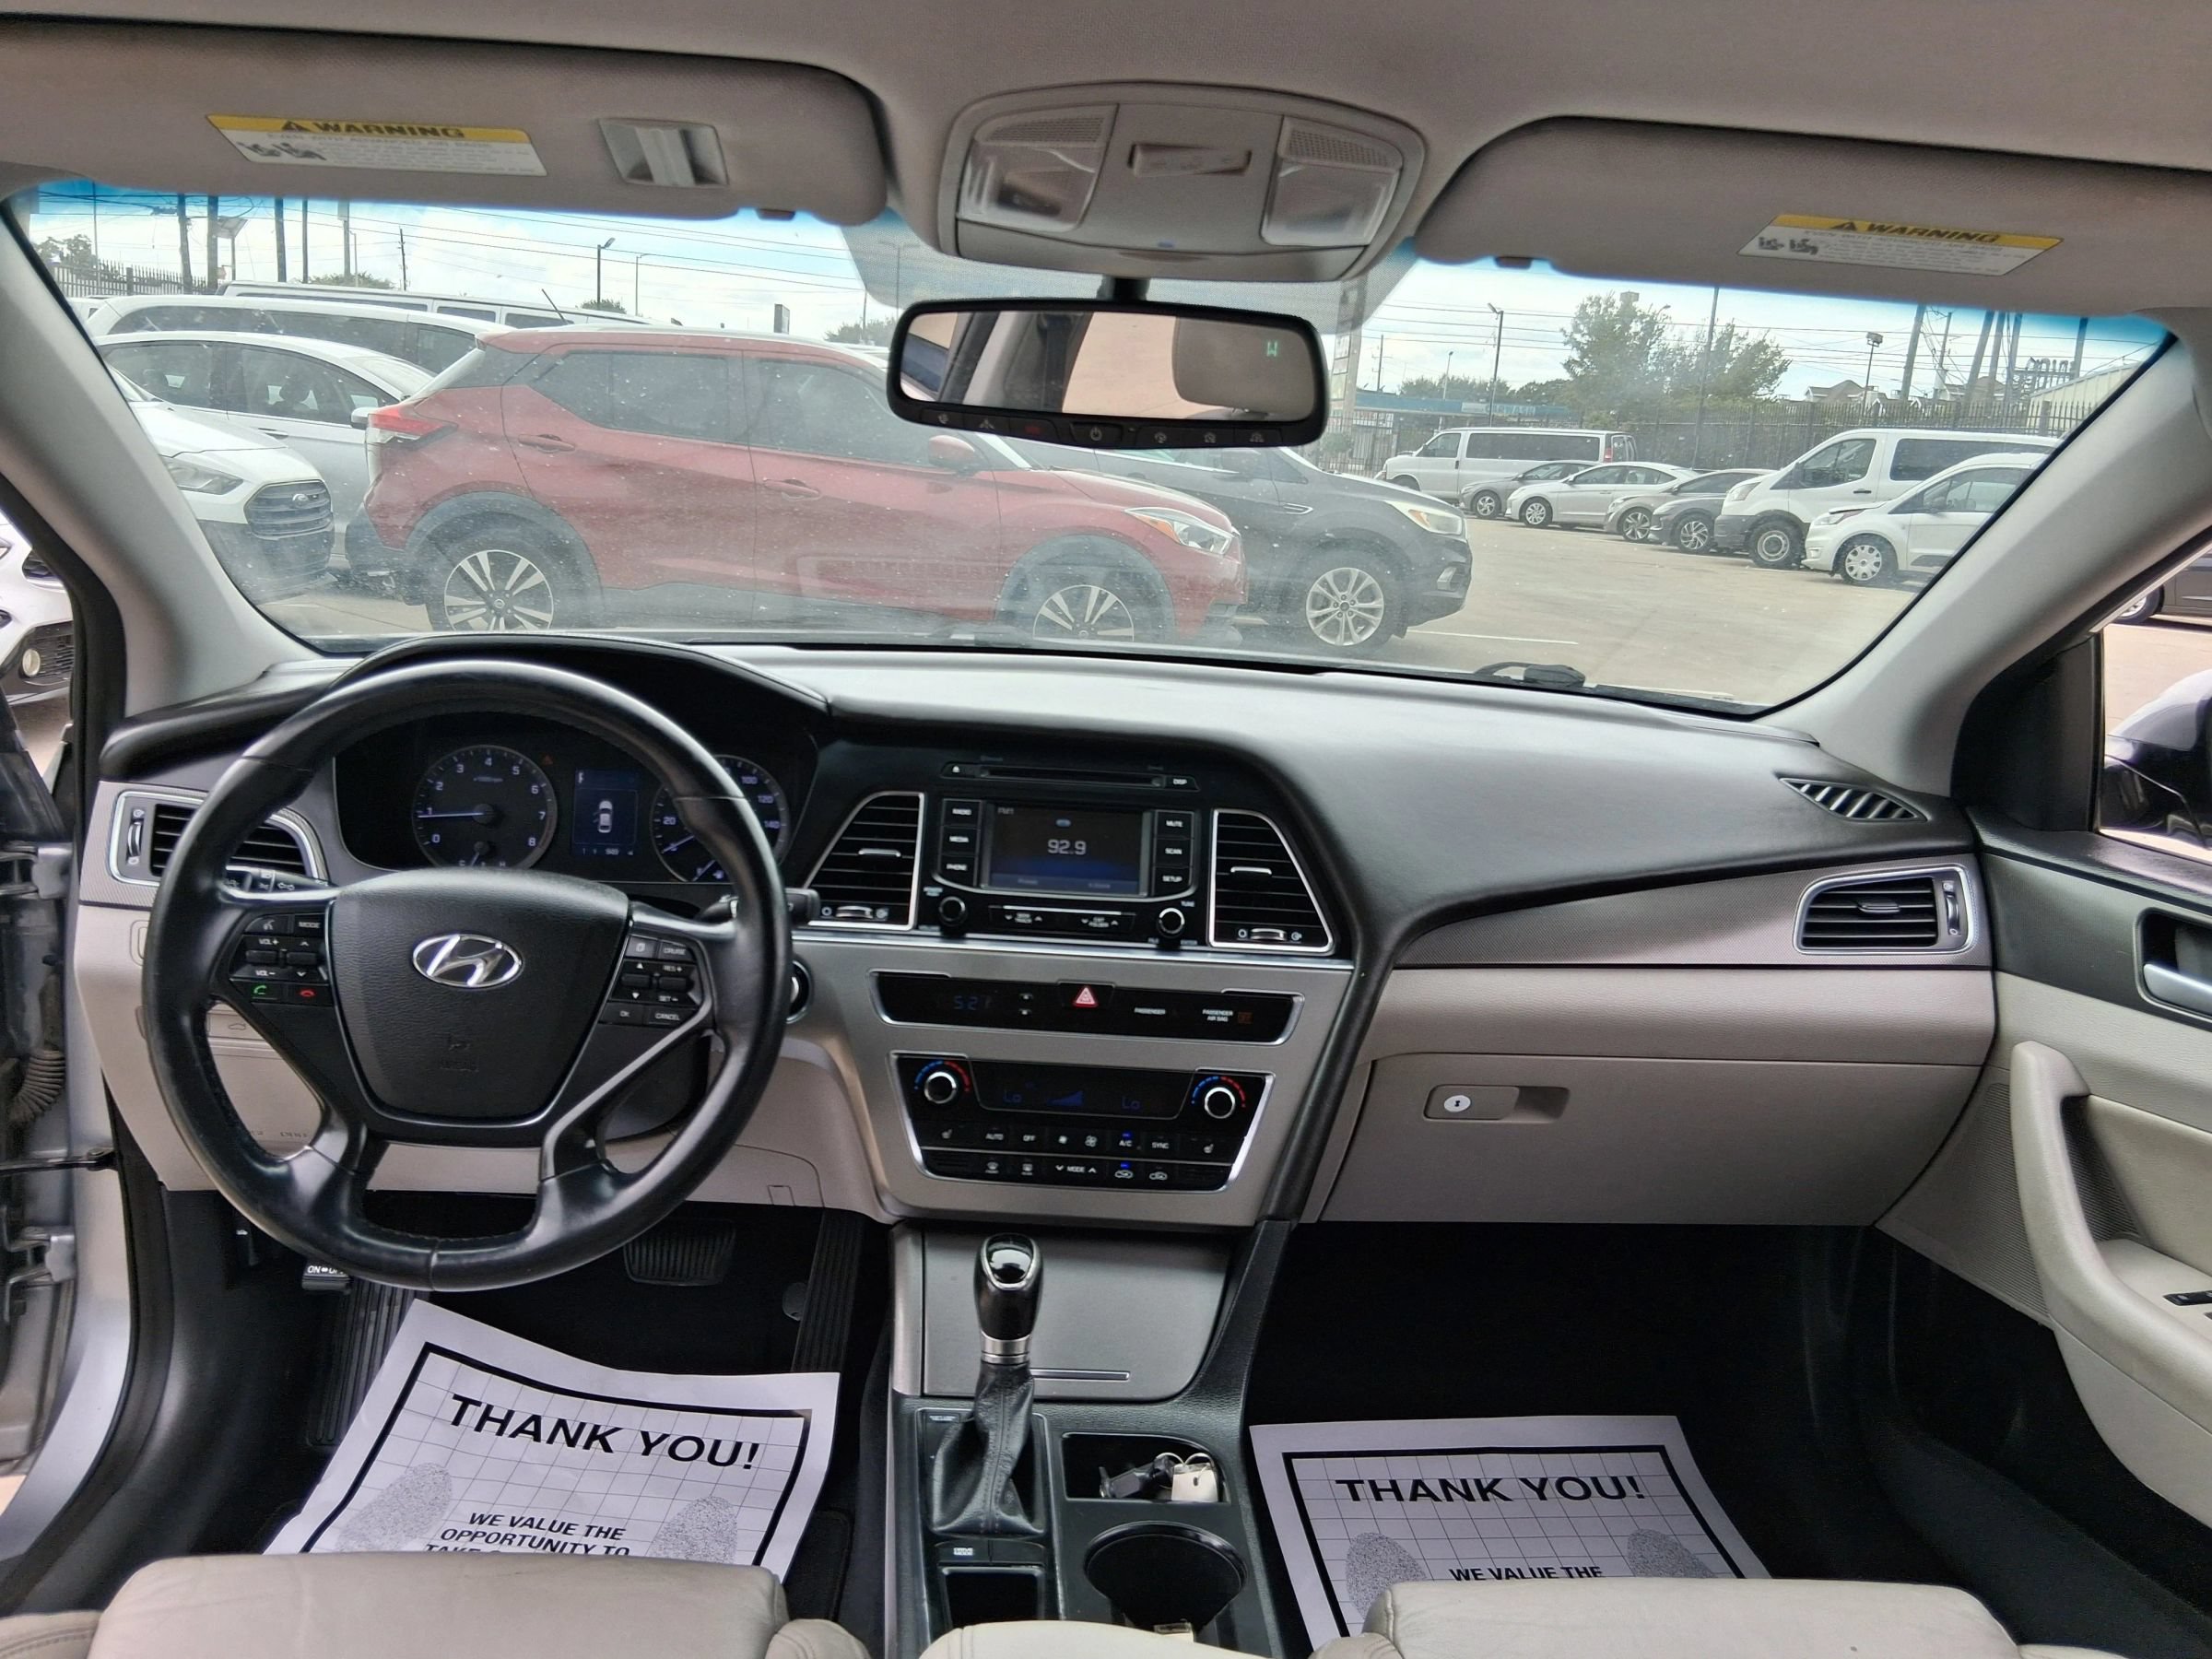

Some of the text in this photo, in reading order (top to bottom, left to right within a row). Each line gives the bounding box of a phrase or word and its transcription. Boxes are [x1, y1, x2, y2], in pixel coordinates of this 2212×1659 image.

[312, 122, 465, 138] WARNING
[1867, 222, 2000, 243] WARNING
[484, 758, 492, 766] 4
[456, 764, 465, 773] 3
[512, 766, 520, 775] 5
[435, 782, 443, 791] 2
[532, 785, 539, 794] 6
[538, 811, 546, 819] 7
[663, 817, 677, 825] 20
[431, 834, 440, 842] 0
[528, 837, 535, 846] 8
[1047, 839, 1087, 855] 92.9
[449, 1394, 759, 1470] THANK YOU!
[1335, 1475, 1645, 1503] THANK YOU!
[468, 1512, 626, 1541] WE VALUE THE
[441, 1528, 630, 1556] OPPORTUNITY TO
[1449, 1566, 1605, 1582] WE VALUE THE
